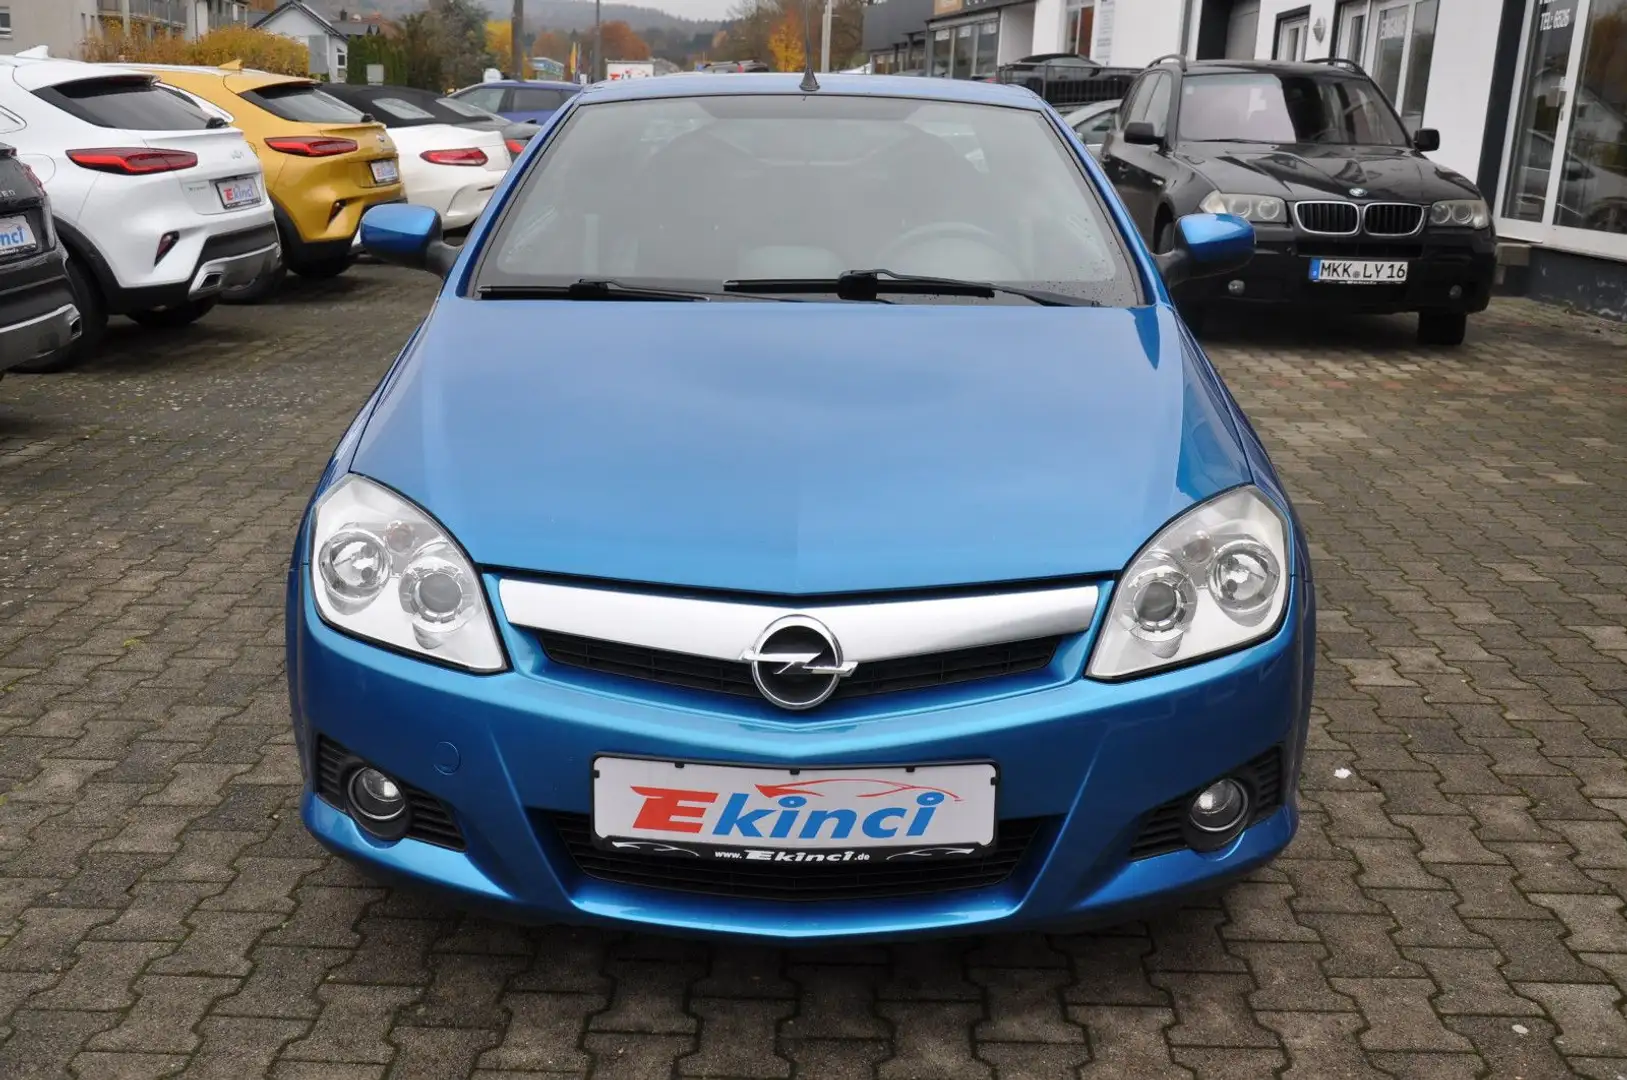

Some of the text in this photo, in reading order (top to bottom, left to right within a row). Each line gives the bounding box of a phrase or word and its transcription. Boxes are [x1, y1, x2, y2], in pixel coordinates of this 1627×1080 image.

[1320, 262, 1353, 278] MKK
[630, 785, 945, 839] Ekinci
[714, 850, 870, 862] www.Ekinci.de
